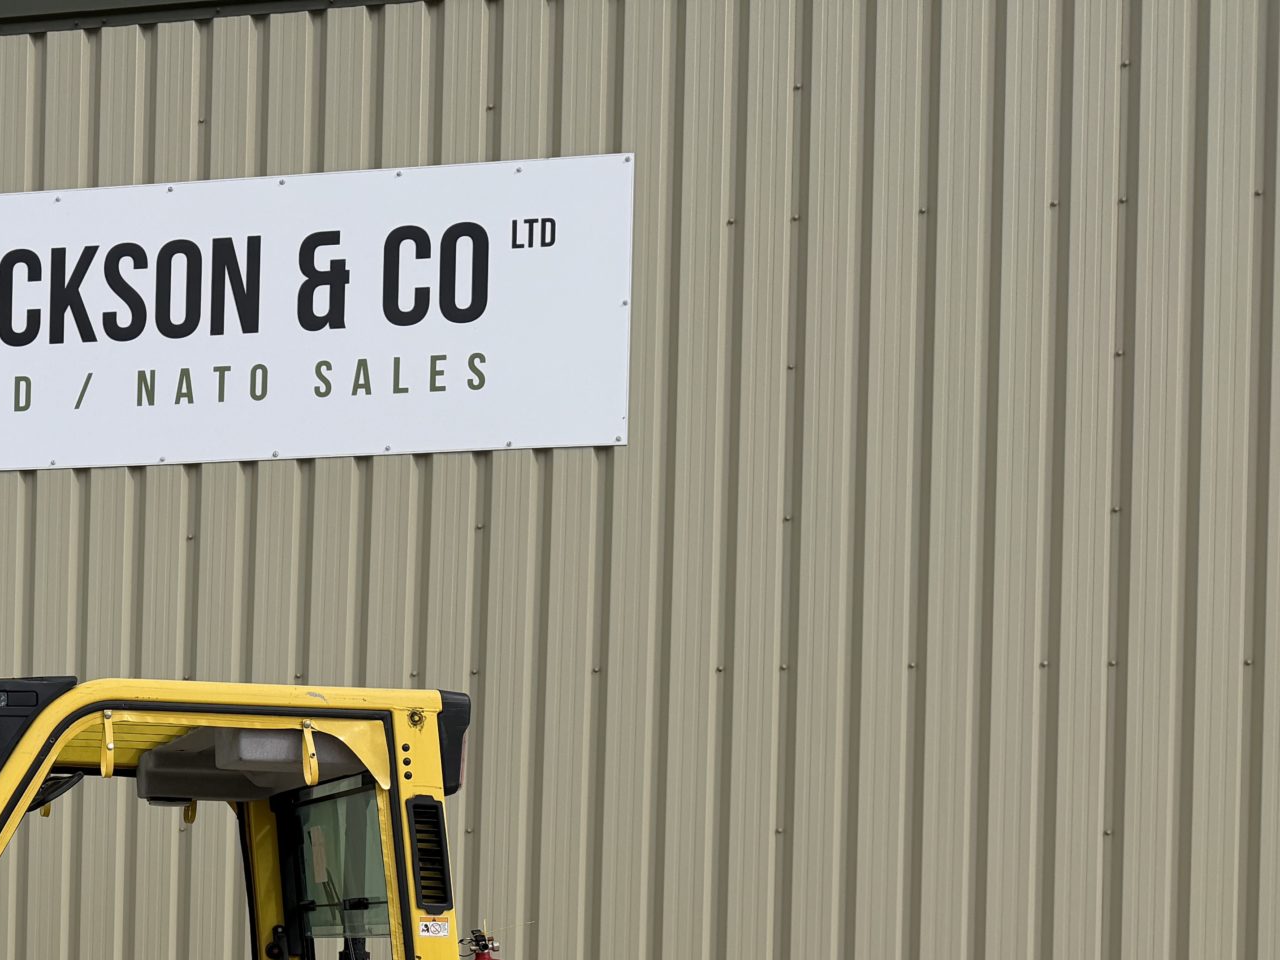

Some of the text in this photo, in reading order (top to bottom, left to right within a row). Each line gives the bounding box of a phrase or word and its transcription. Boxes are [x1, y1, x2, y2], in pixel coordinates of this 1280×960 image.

[296, 229, 351, 332] &
[382, 221, 490, 327] CO
[511, 217, 558, 250] LTD
[136, 363, 269, 407] NATO
[313, 352, 487, 398] SALES
